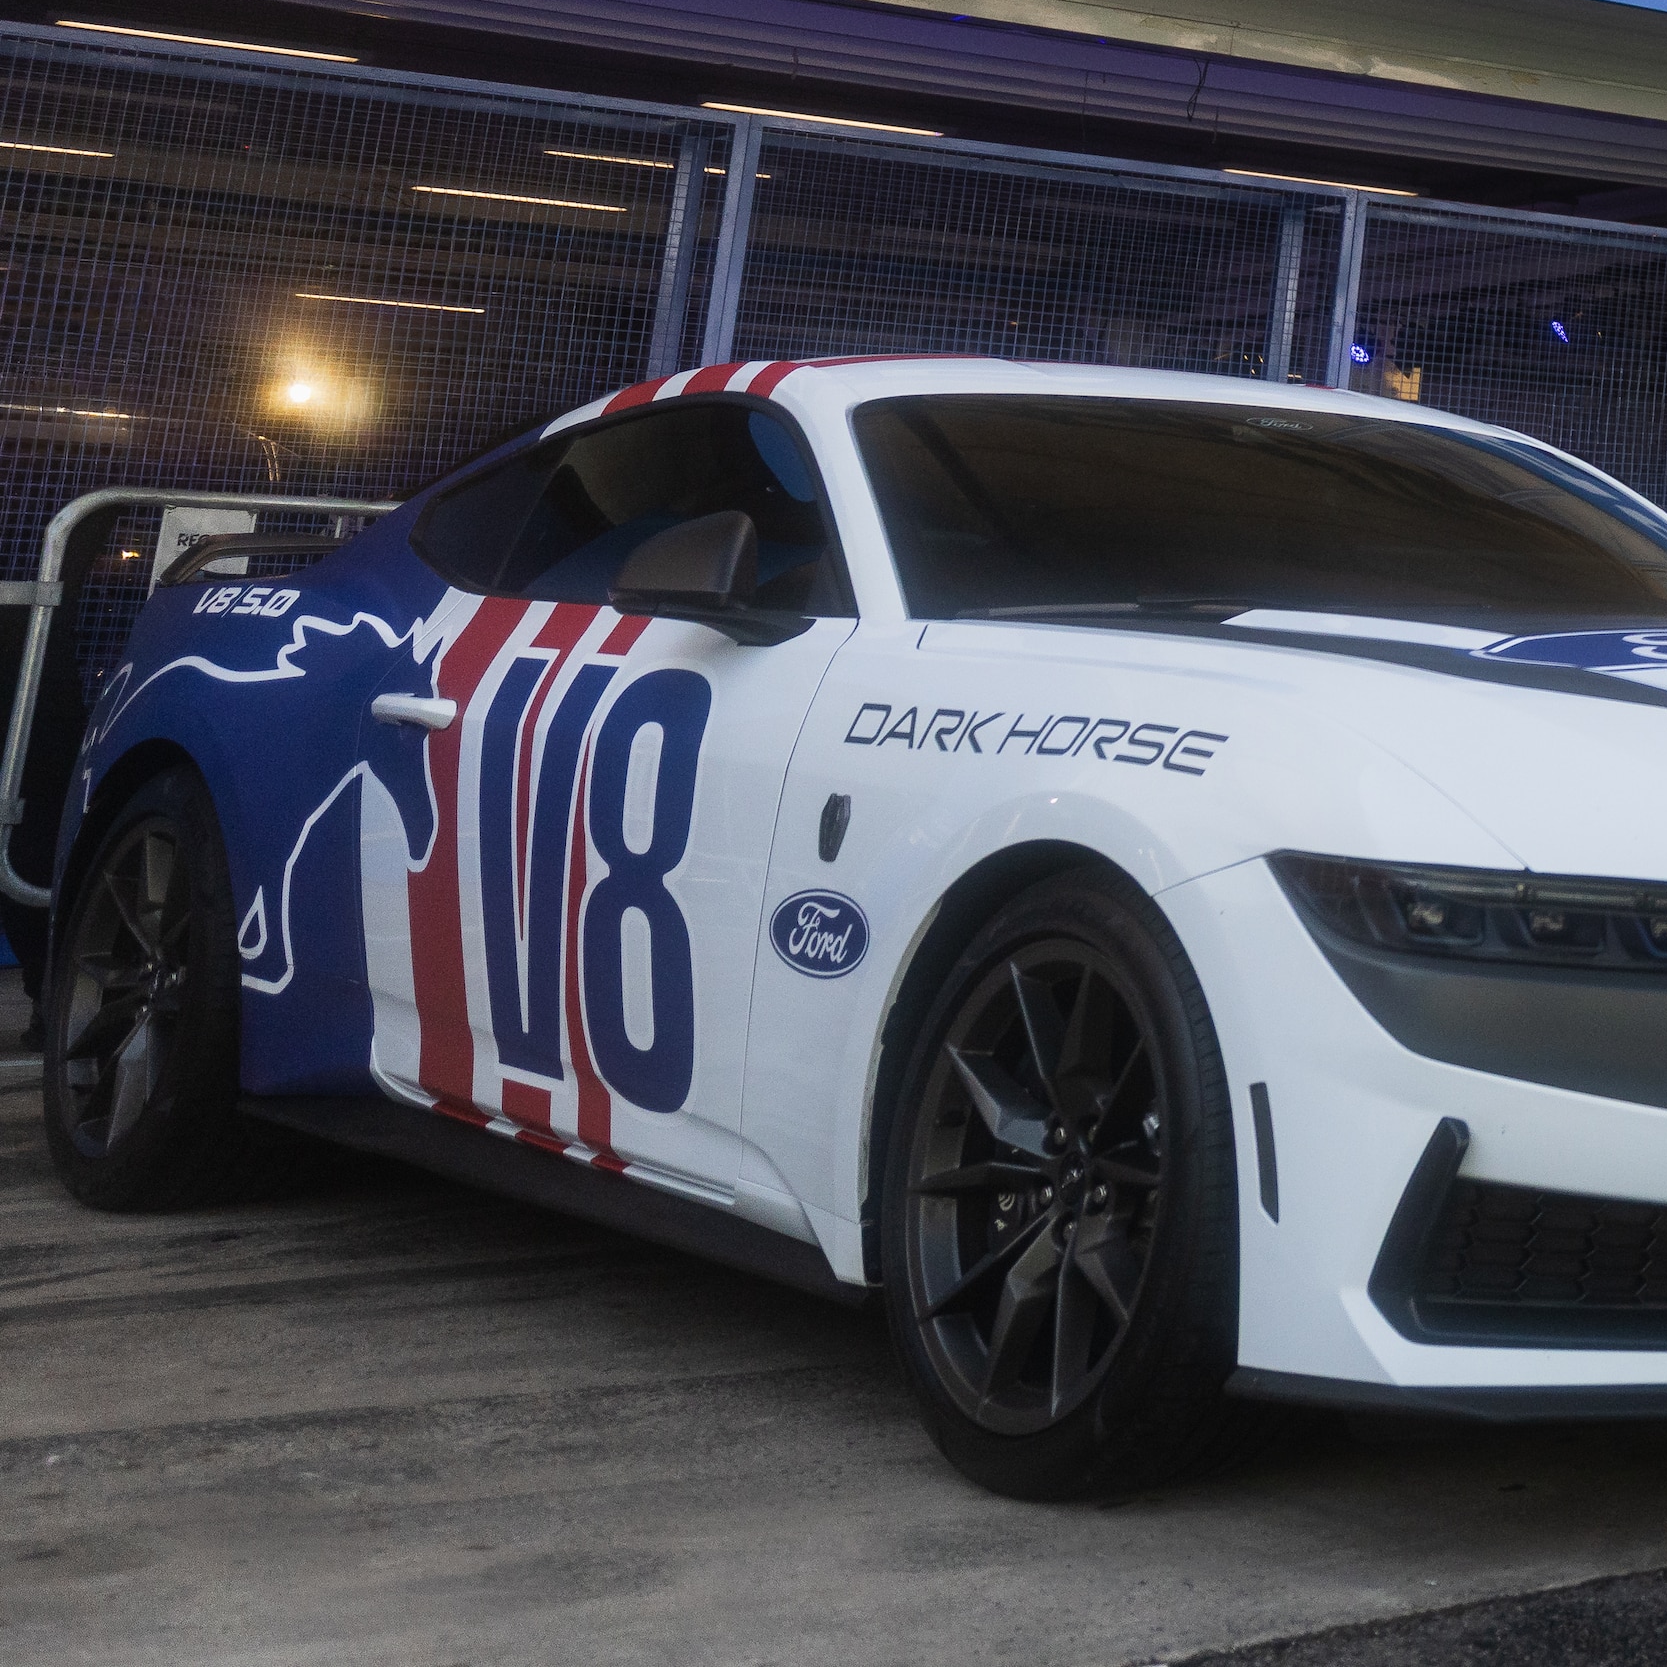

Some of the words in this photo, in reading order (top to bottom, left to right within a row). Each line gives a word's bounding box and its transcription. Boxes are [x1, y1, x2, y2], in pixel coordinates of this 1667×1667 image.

[844, 703, 1006, 753] DARK
[997, 714, 1229, 776] HORSE
[475, 652, 715, 1116] V8
[788, 901, 853, 964] Ford
